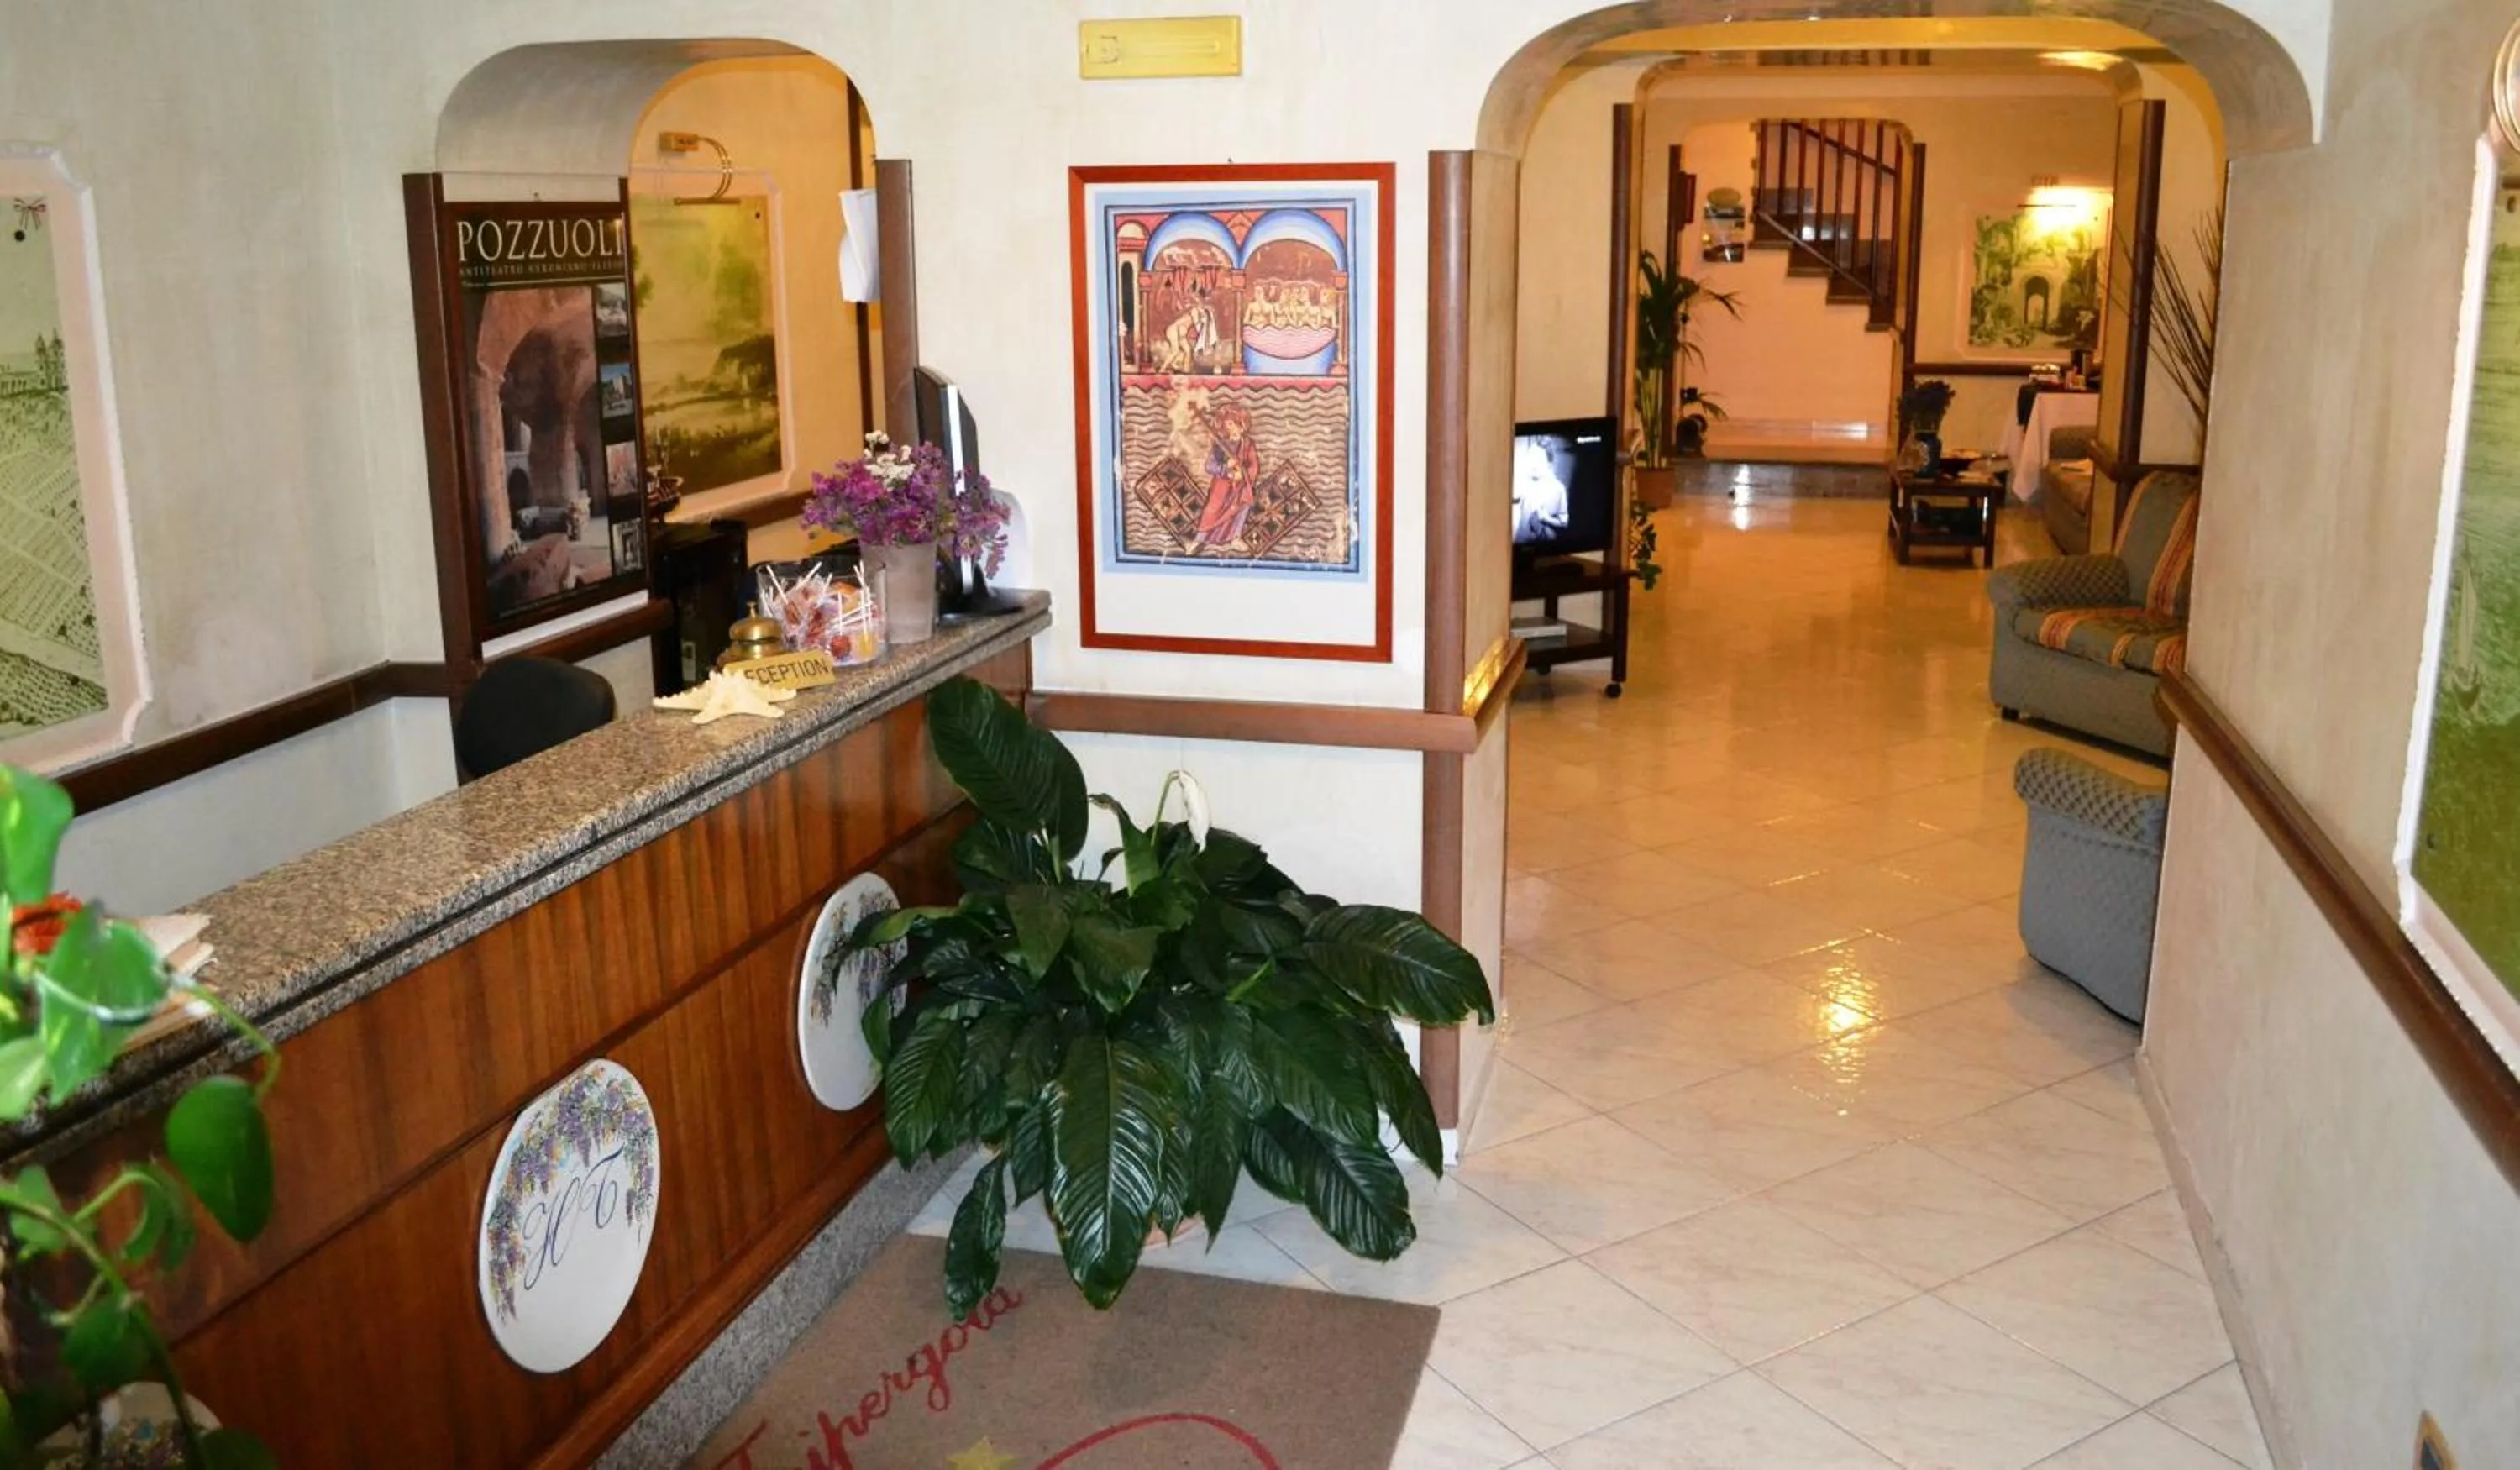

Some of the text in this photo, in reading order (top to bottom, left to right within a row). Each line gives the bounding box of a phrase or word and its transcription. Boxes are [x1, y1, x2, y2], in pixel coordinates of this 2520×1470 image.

[456, 218, 623, 262] POZZUOLI
[743, 658, 830, 685] ECEPTION
[712, 1285, 1023, 1470] Tipergoa
